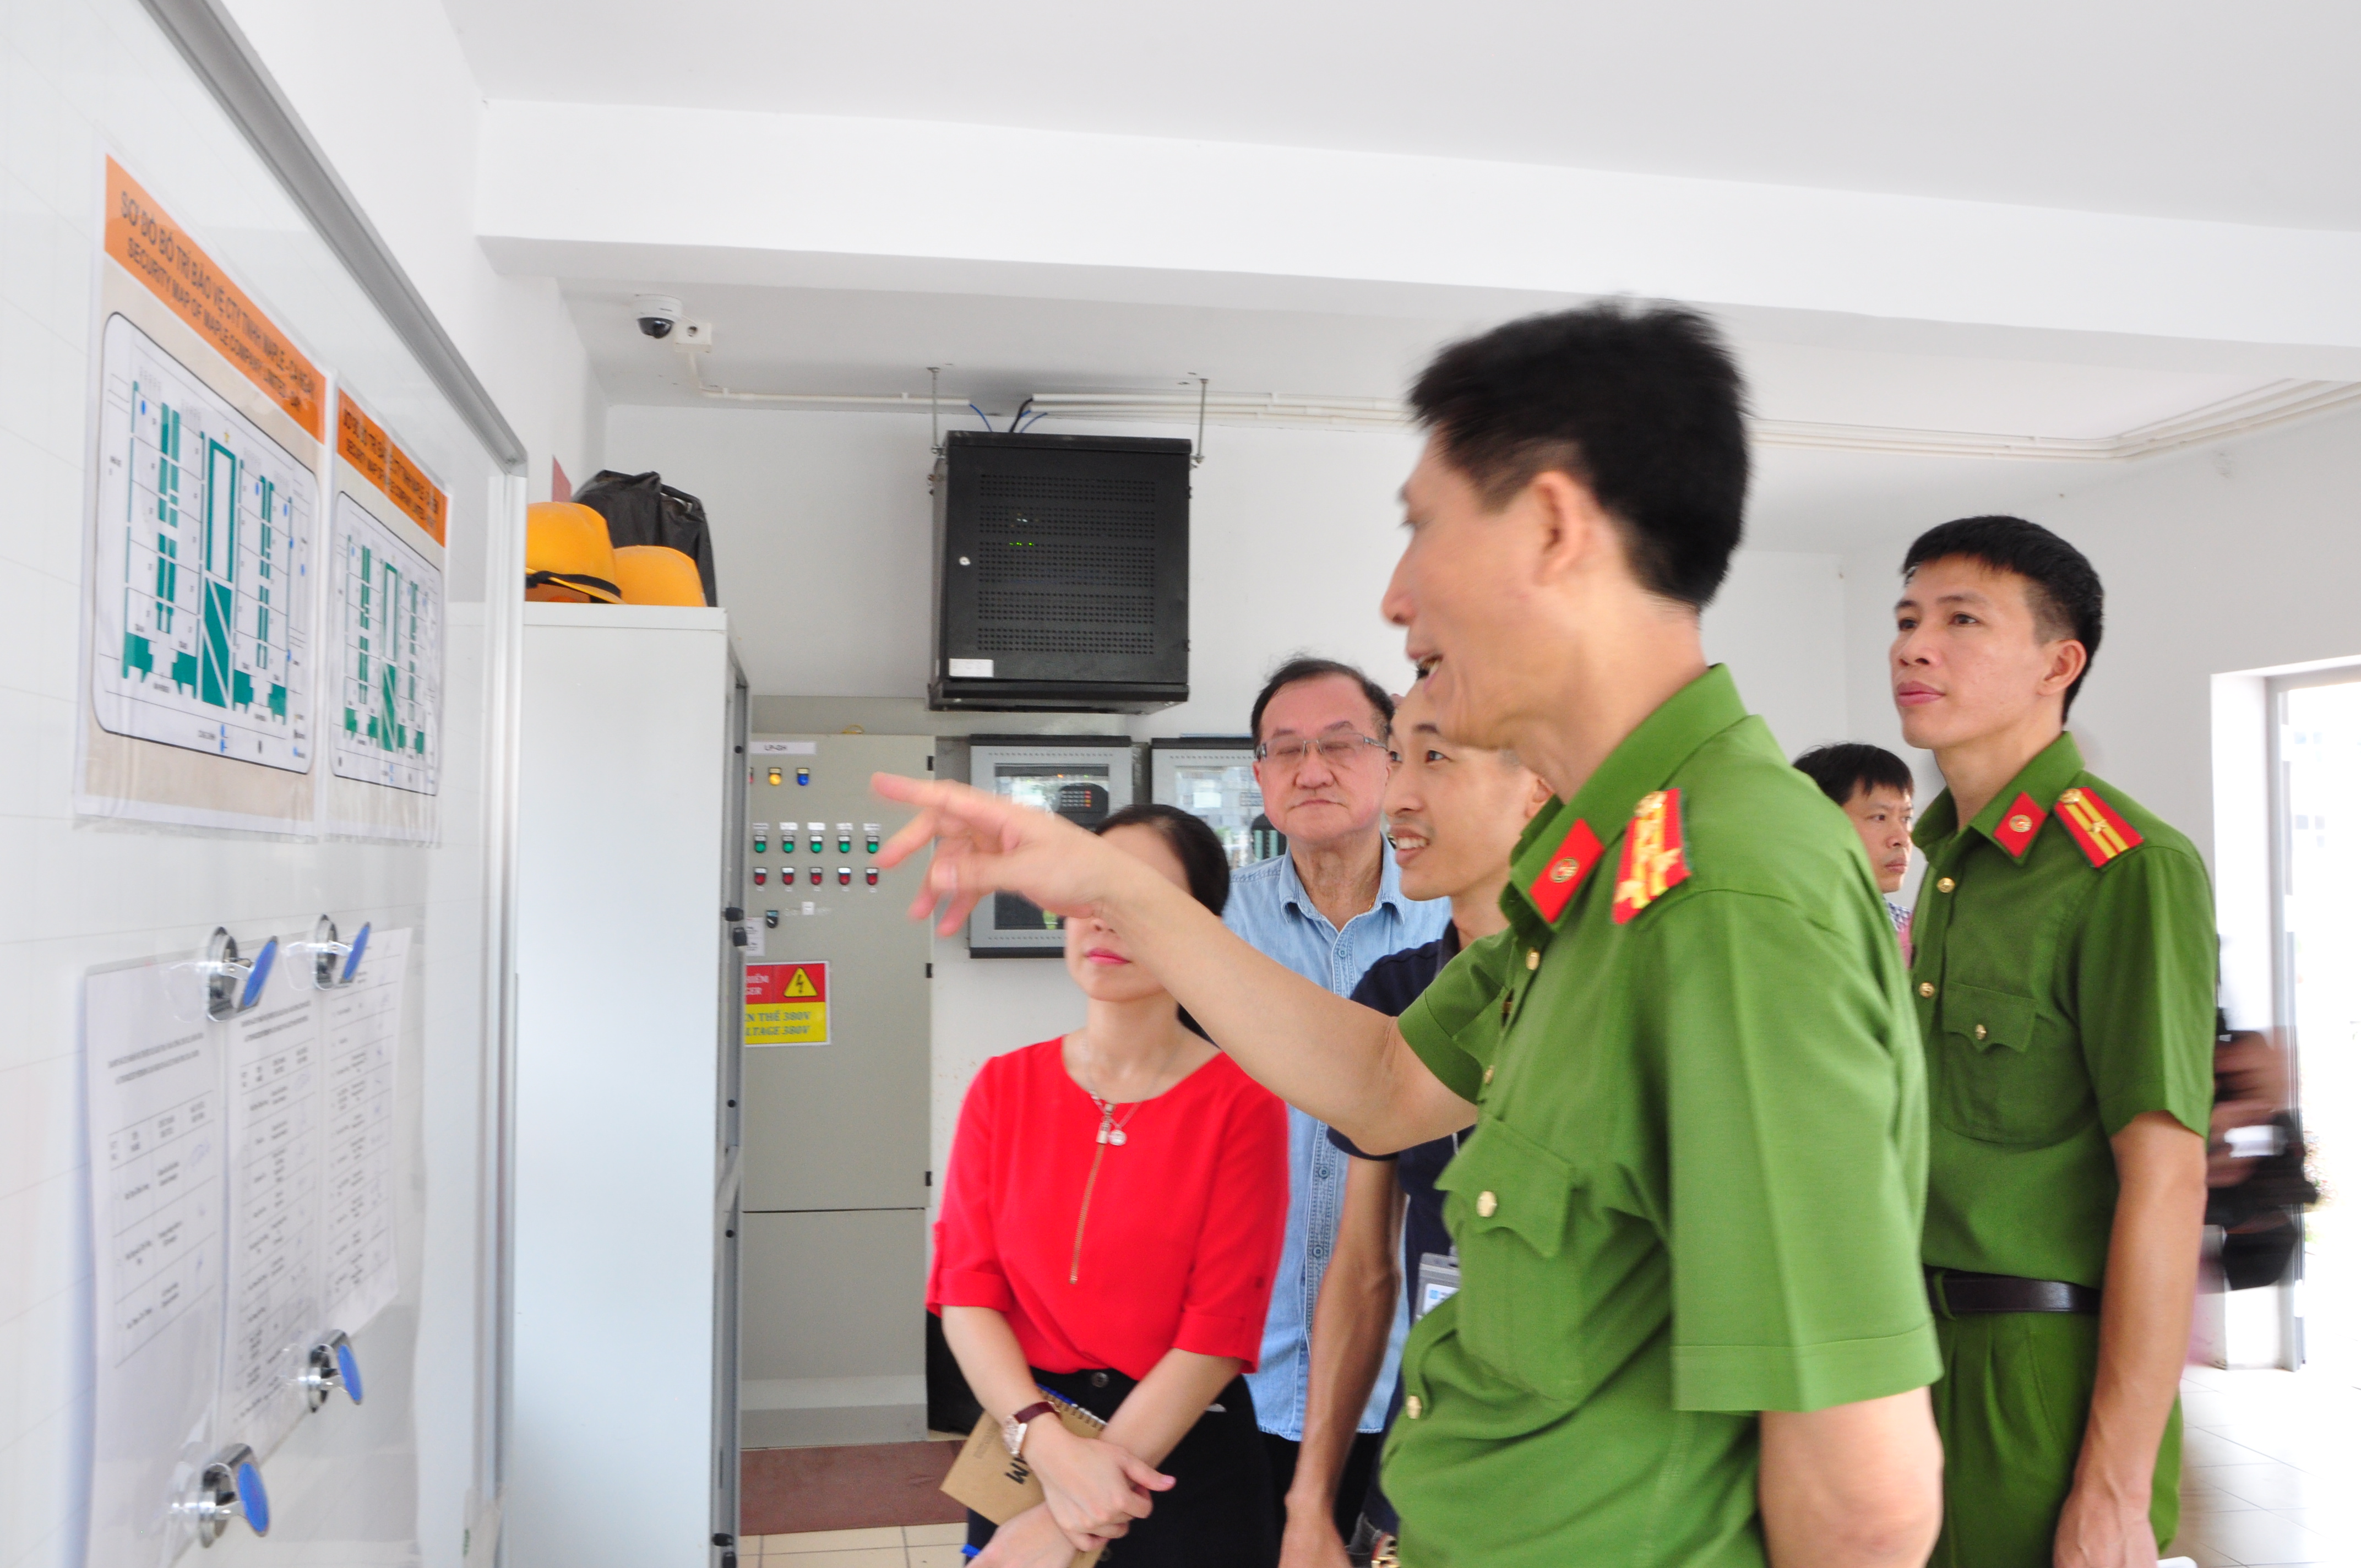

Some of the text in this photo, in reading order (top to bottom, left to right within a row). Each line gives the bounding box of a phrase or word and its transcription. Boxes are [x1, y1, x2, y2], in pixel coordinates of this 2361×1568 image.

[127, 237, 171, 292] SECURITY
[172, 279, 191, 308] MAP
[191, 298, 202, 319] OF
[203, 308, 229, 346] MAPLE
[783, 1011, 812, 1020] 380V
[746, 1026, 811, 1036] LTAGE 380V
